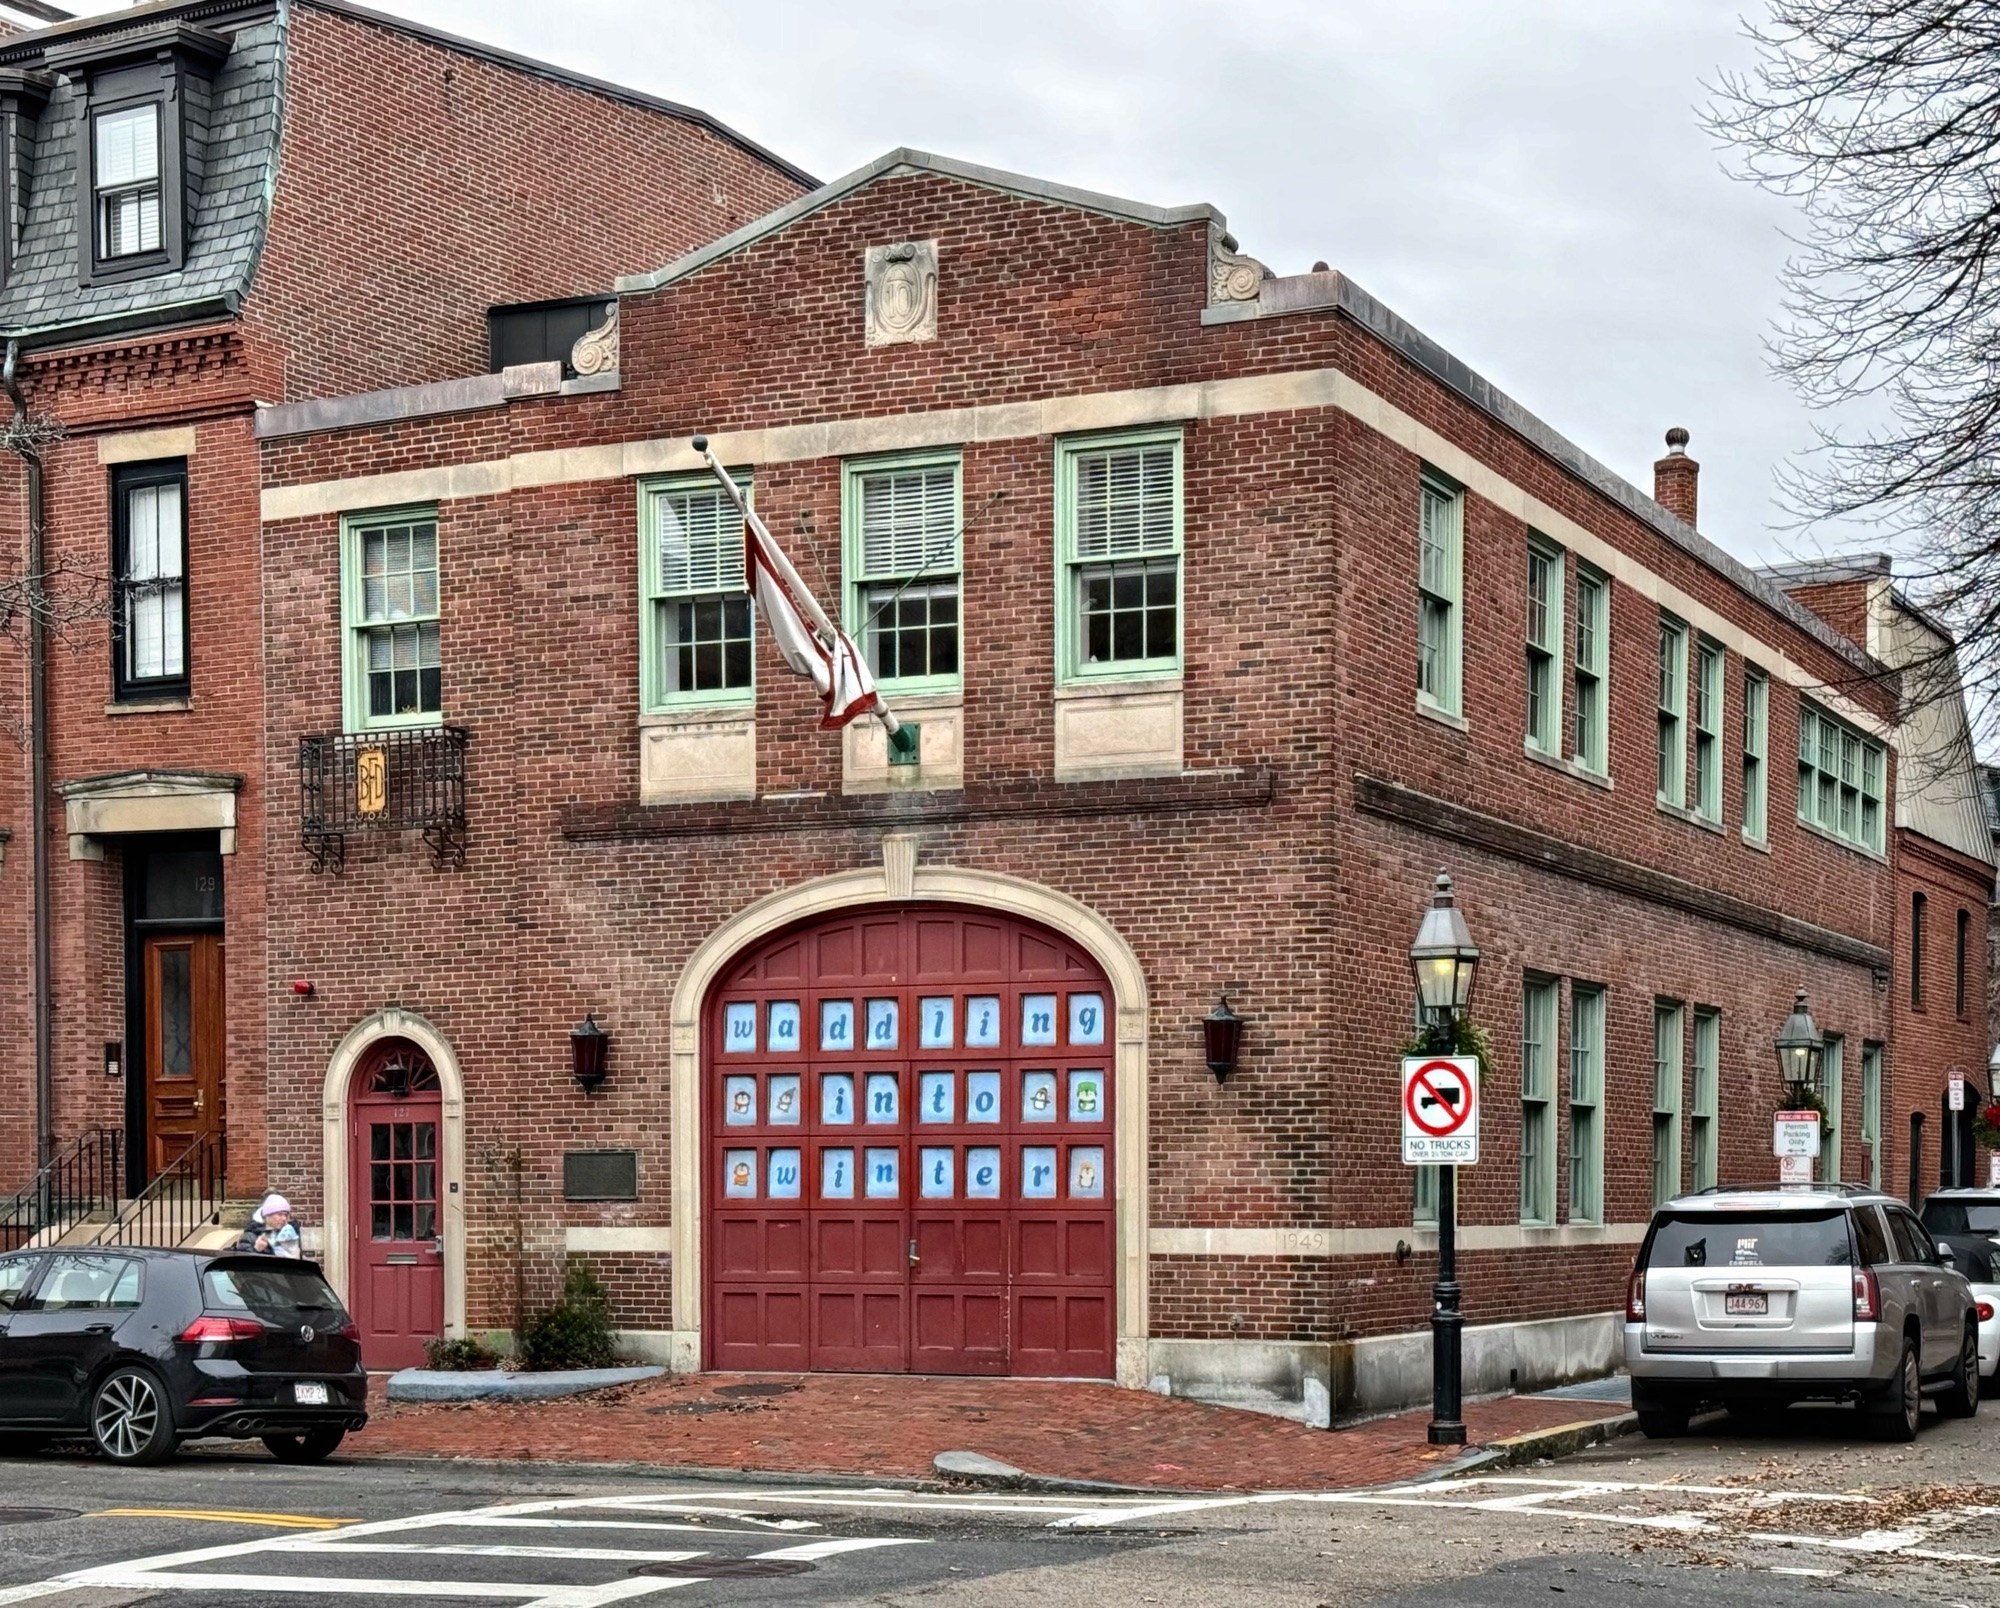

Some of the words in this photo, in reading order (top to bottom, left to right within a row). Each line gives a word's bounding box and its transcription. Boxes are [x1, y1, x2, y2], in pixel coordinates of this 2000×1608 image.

[887, 283, 913, 319] 10
[195, 876, 215, 892] 129
[734, 1005, 1097, 1041] waddling
[834, 1084, 994, 1114] into
[393, 1107, 410, 1118] 127
[1410, 1140, 1425, 1150] NO
[1429, 1140, 1471, 1150] TRUCKS
[1788, 1138, 1805, 1146] Only
[776, 1160, 1050, 1189] winter
[1283, 1232, 1324, 1250] 1949
[1737, 1238, 1759, 1249] MIT
[1728, 1283, 1762, 1291] GMC
